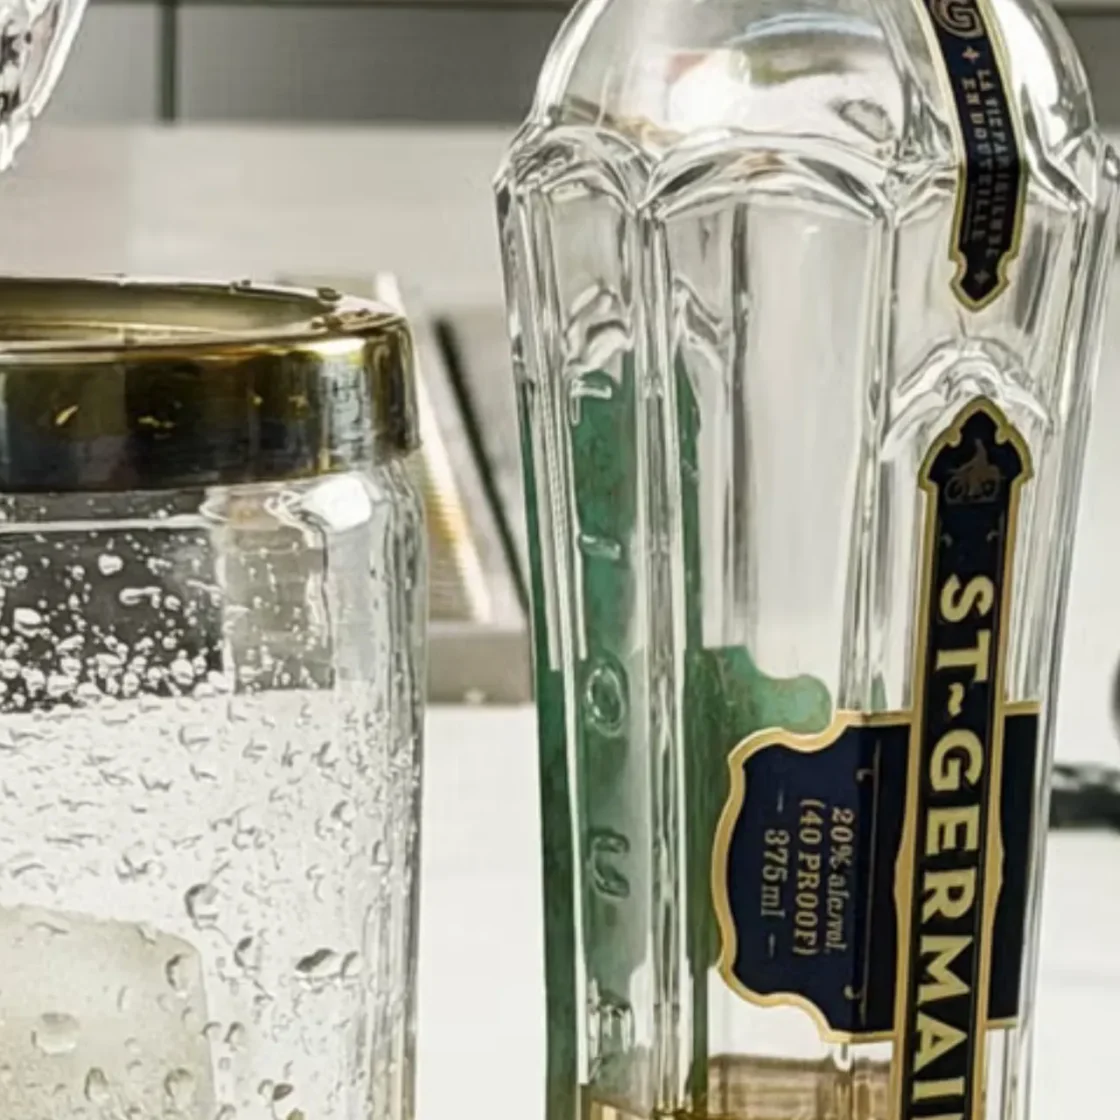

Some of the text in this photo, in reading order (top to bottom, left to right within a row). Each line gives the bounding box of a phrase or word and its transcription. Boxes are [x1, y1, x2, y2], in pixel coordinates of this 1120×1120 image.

[791, 798, 826, 957] (40 PROOF)
[828, 806, 856, 870] 20%
